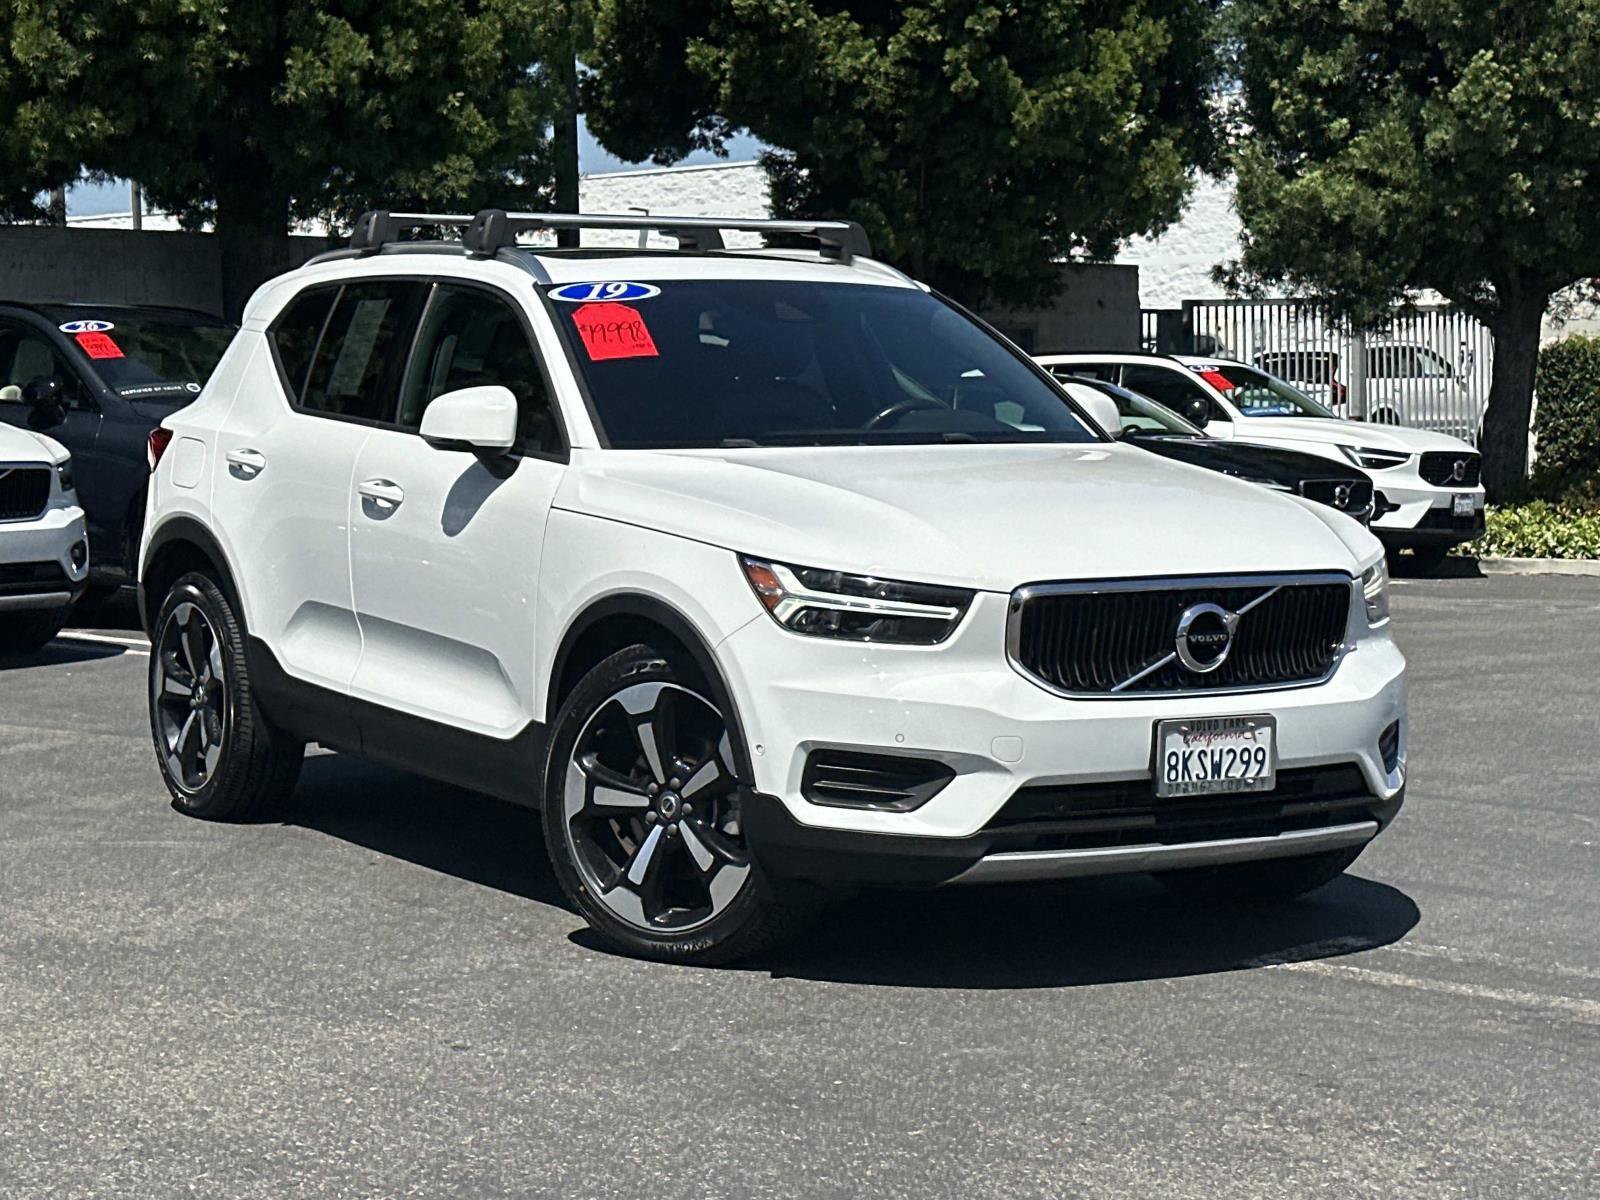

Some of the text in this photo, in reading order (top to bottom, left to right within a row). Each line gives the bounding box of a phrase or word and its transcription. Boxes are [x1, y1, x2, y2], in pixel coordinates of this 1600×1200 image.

[584, 282, 628, 299] 19
[1189, 634, 1227, 642] VOLVO
[1190, 719, 1246, 732] VOLVO CARS
[1166, 746, 1266, 782] 8KSW299
[1167, 780, 1213, 795] ORANGE
